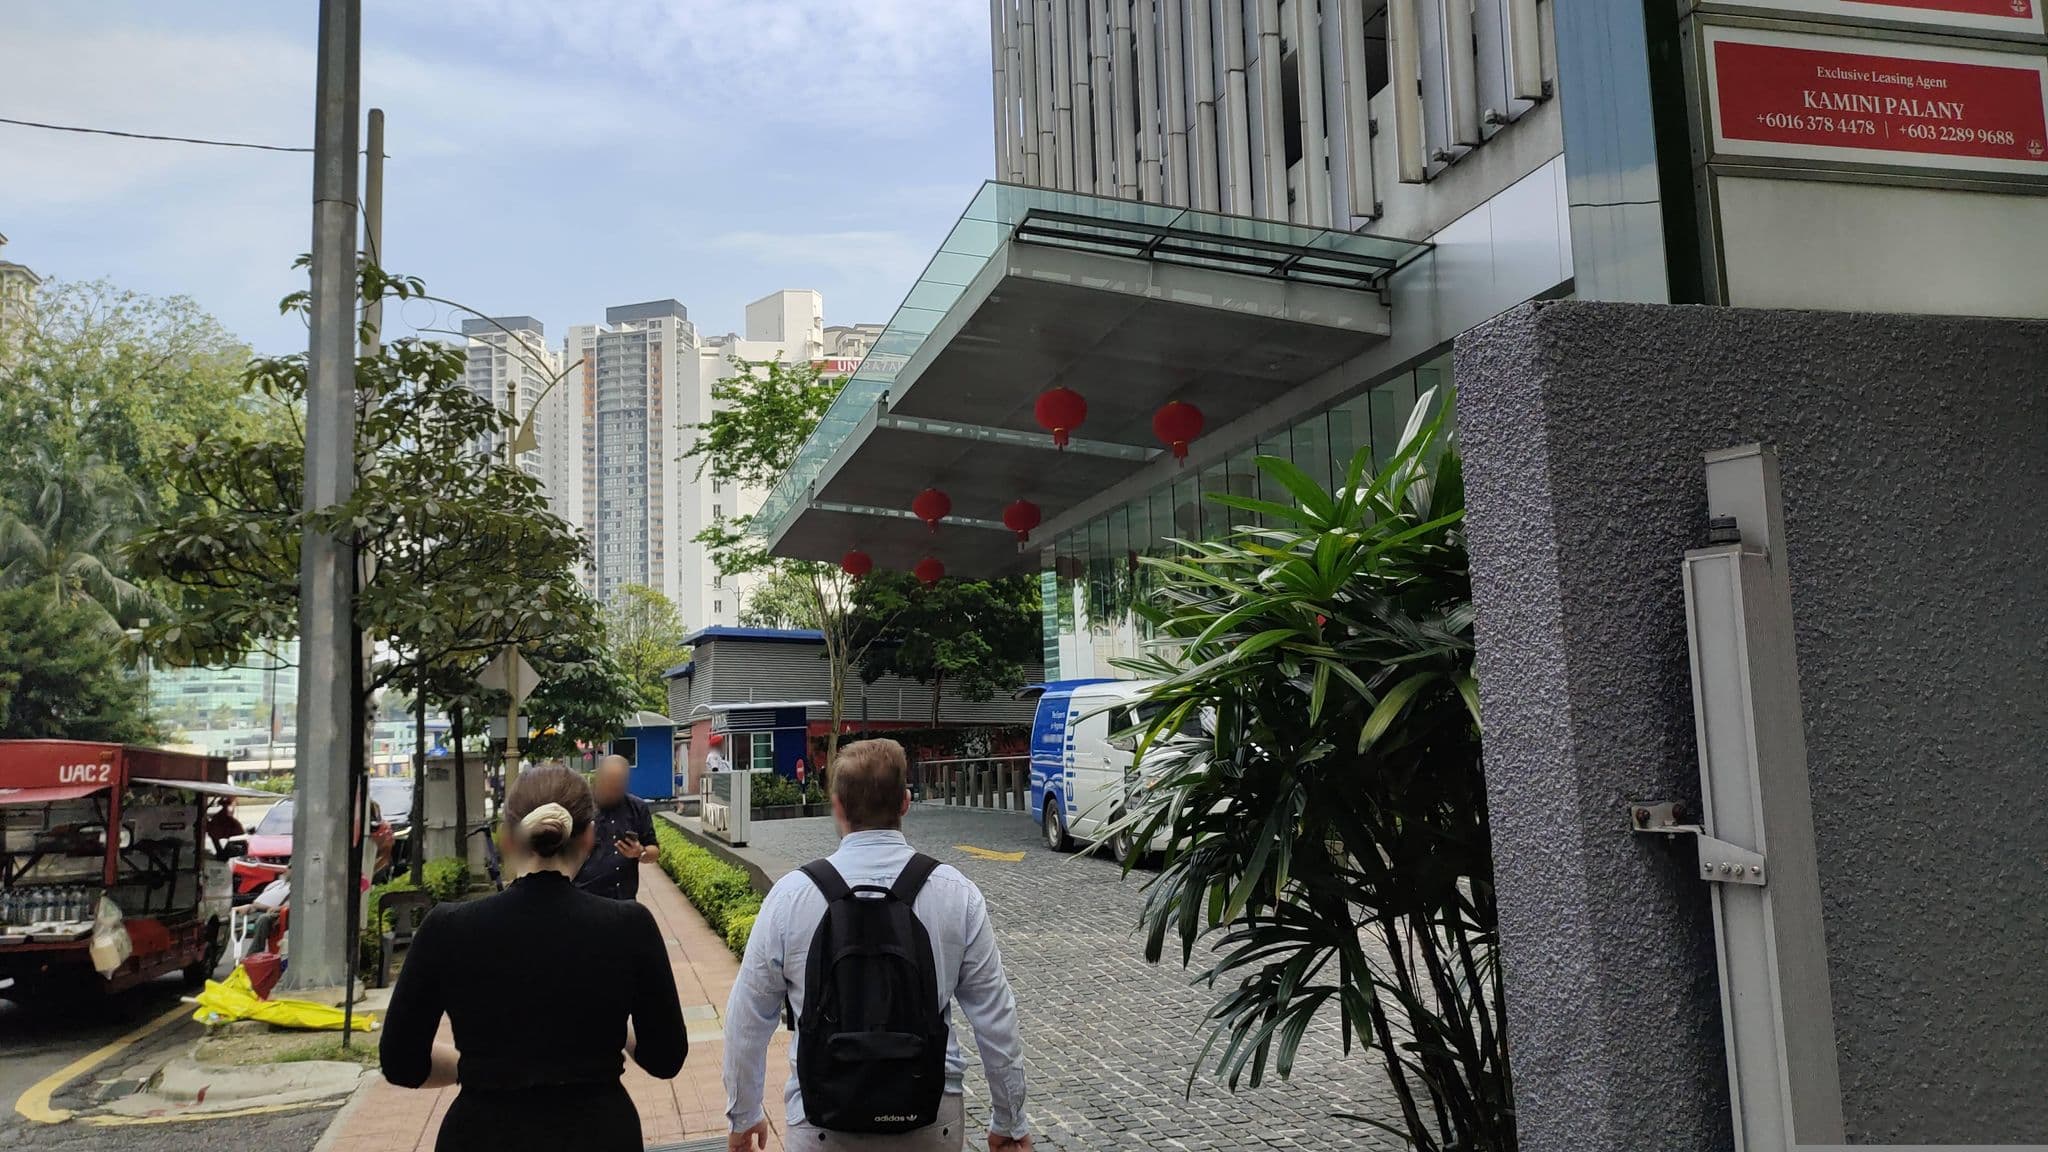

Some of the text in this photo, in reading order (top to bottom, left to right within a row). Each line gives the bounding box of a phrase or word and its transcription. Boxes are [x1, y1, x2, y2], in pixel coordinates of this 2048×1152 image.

[1817, 66, 1948, 90] Exclusive Leasing Agent
[1803, 90, 1964, 120] KAMINI PALANY
[1757, 112, 2015, 145] +6016 378 4478 +603 2289 9688
[60, 764, 111, 783] UAC 2
[874, 1114, 905, 1122] adidas
